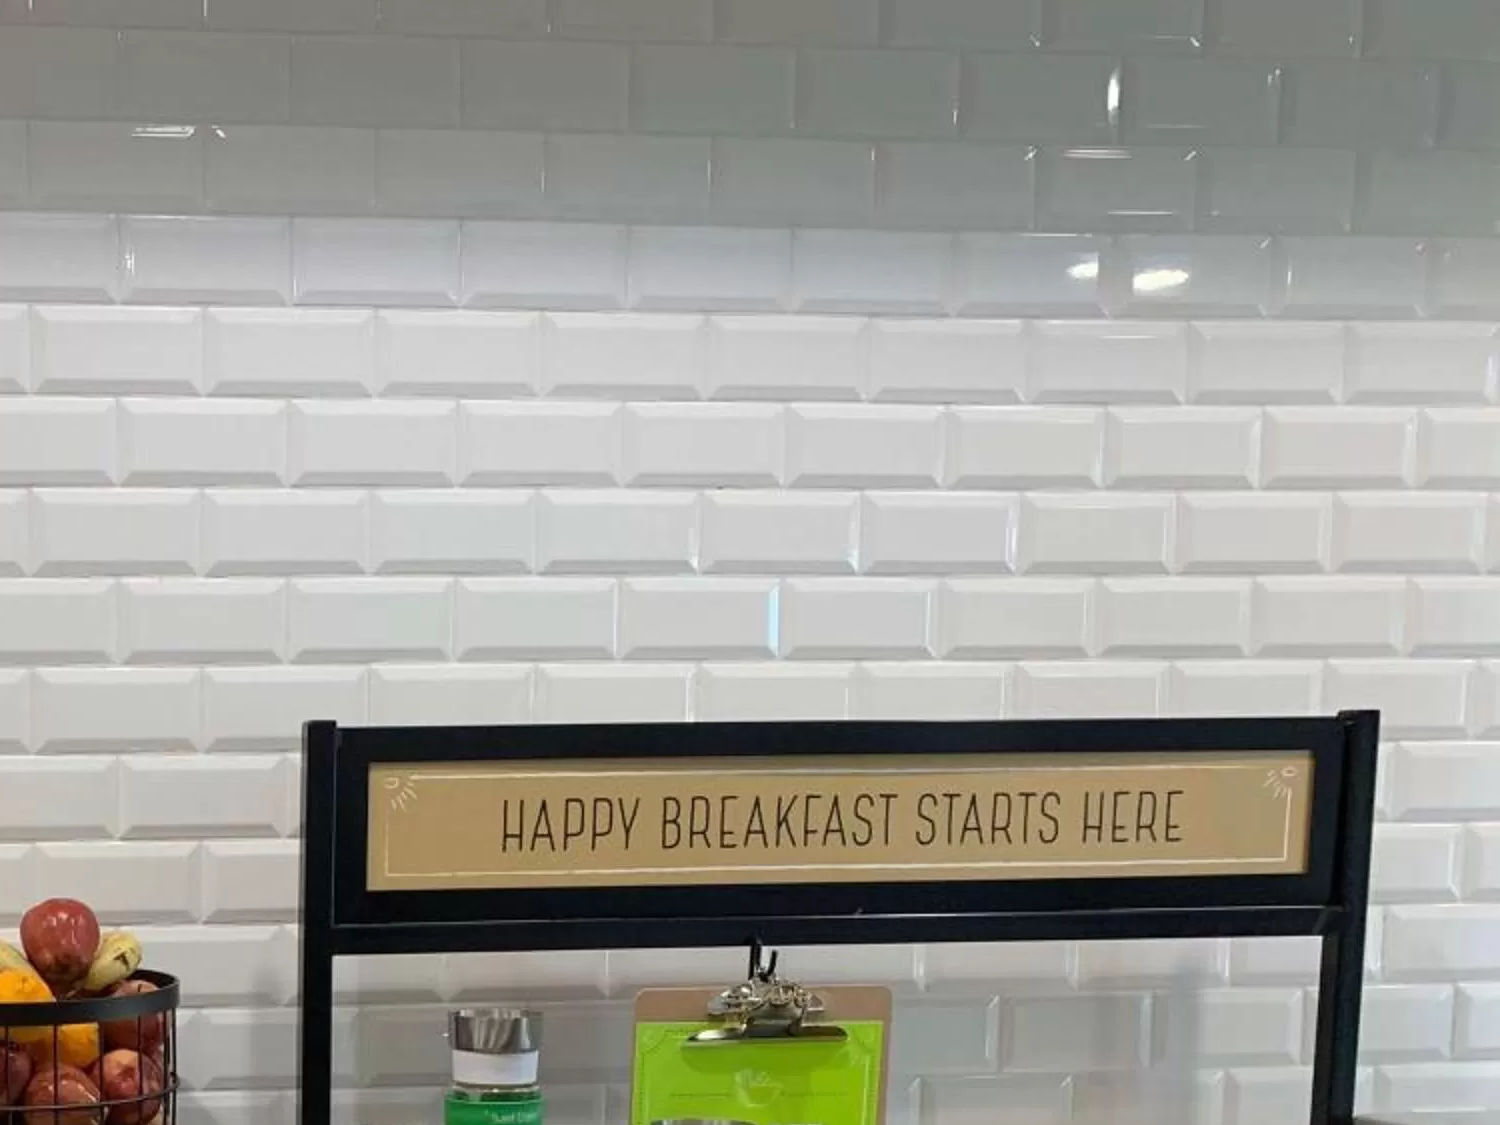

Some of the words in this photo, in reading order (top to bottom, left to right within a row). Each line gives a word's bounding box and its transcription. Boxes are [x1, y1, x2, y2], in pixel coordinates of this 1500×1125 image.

[501, 797, 641, 852] HAPPY
[661, 793, 899, 849] BREAKFAST
[915, 791, 1061, 846] STARTS
[1082, 790, 1185, 844] HERE
